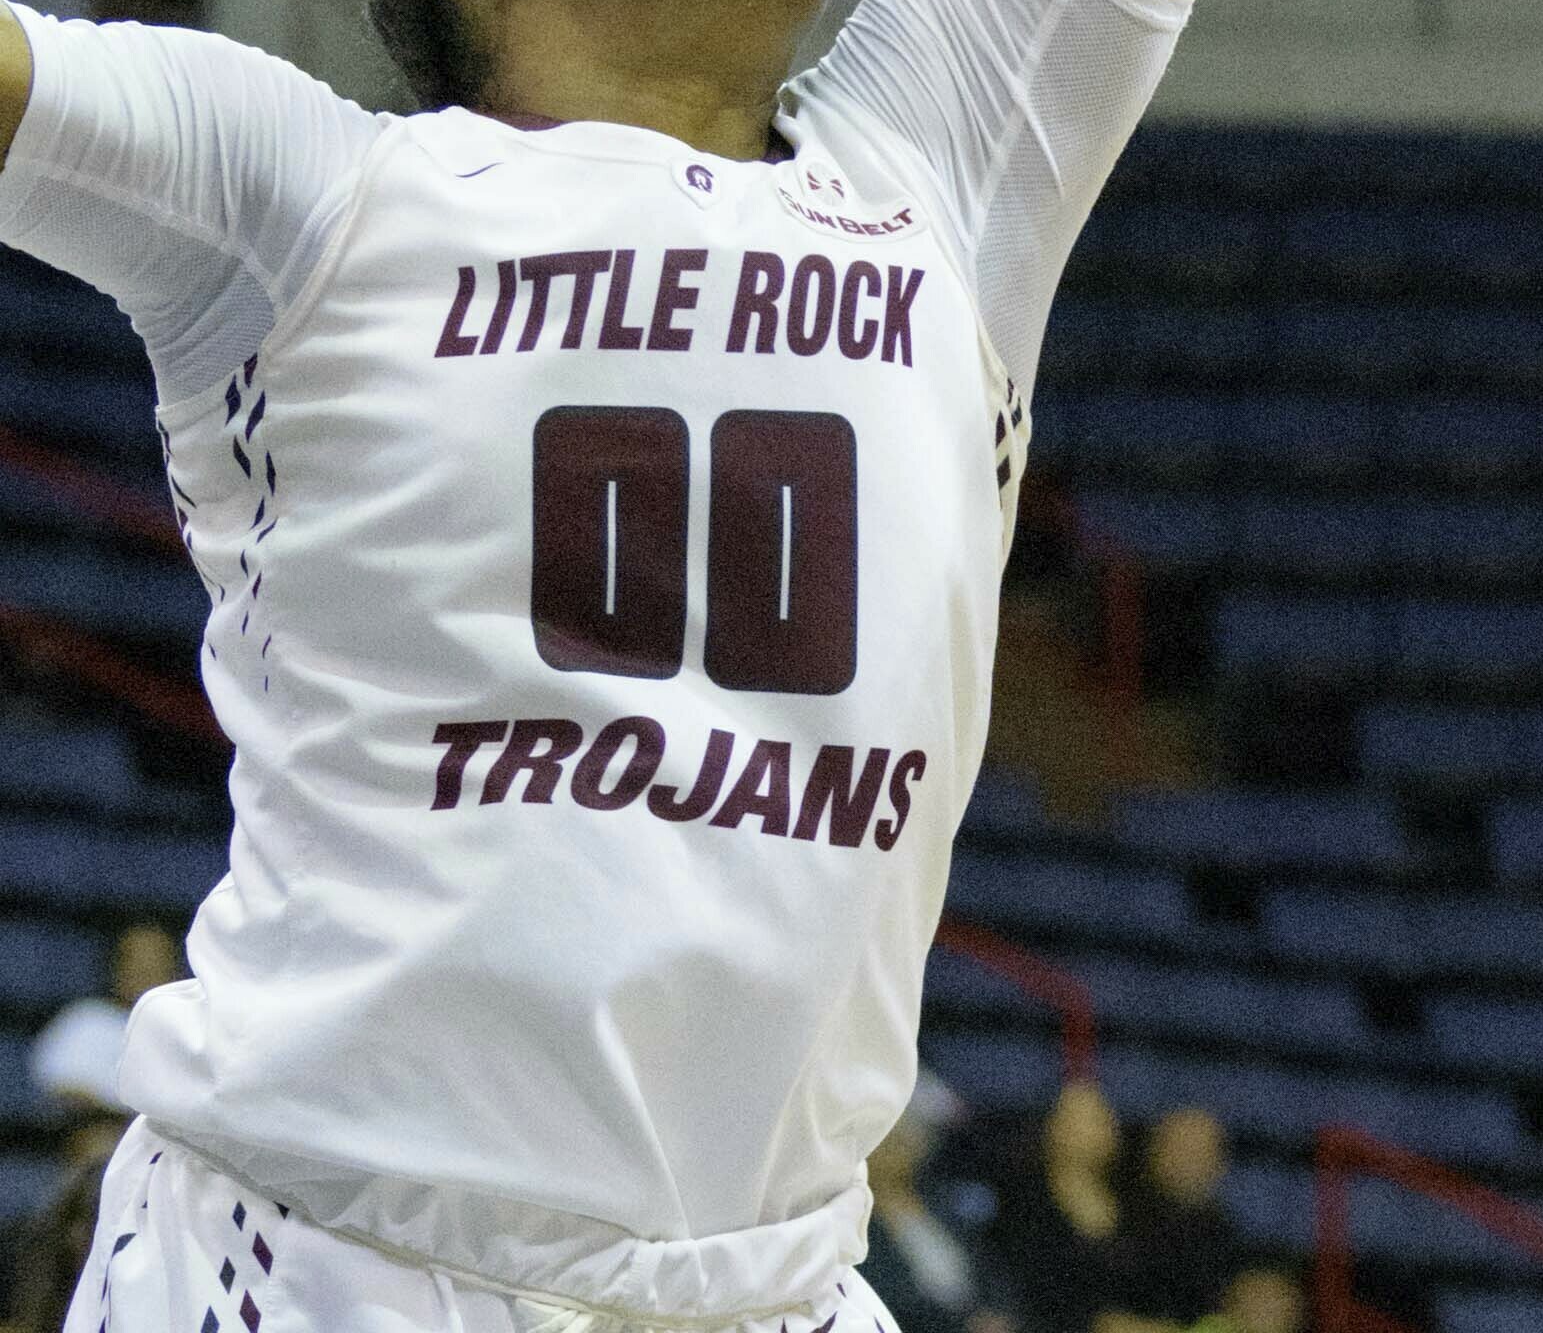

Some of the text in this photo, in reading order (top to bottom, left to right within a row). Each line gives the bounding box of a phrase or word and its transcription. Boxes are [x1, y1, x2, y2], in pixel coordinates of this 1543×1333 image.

[434, 248, 925, 368] LITTLE ROCK
[531, 404, 858, 696] 00
[430, 714, 927, 853] TROJANS
